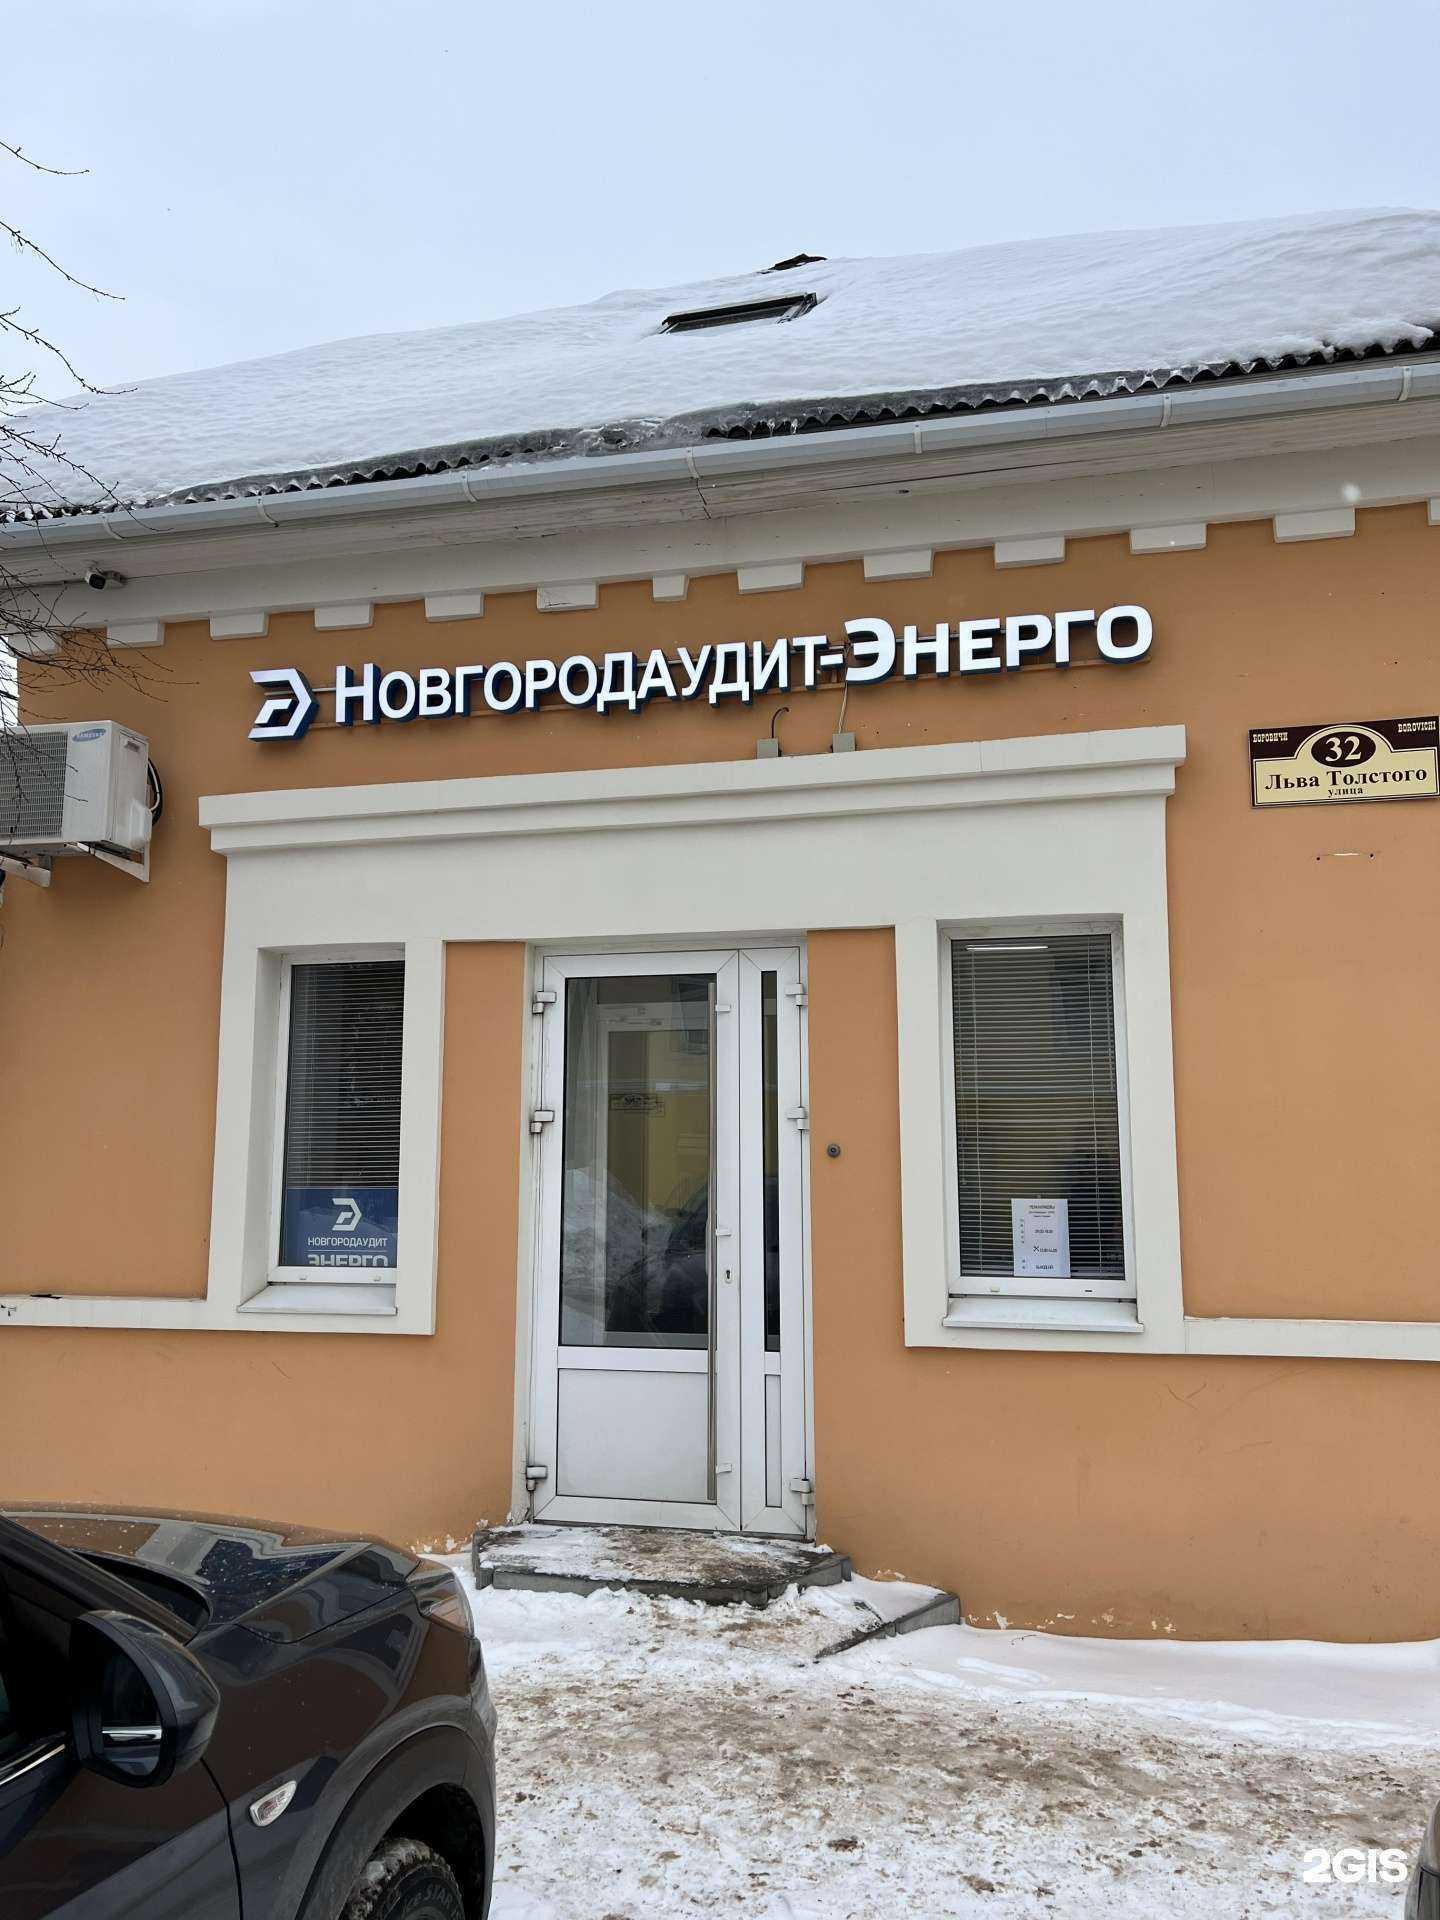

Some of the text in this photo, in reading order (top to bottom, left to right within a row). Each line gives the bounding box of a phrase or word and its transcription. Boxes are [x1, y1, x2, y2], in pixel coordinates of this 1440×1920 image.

[1397, 720, 1436, 733] BOROVICHI
[1252, 732, 1288, 743] БОРОВИЧИ
[1325, 735, 1362, 762] 32
[1265, 768, 1428, 790] Льва Толстого
[1328, 786, 1364, 798] улица
[307, 1236, 388, 1249] НОВГОРОДАУДИТ
